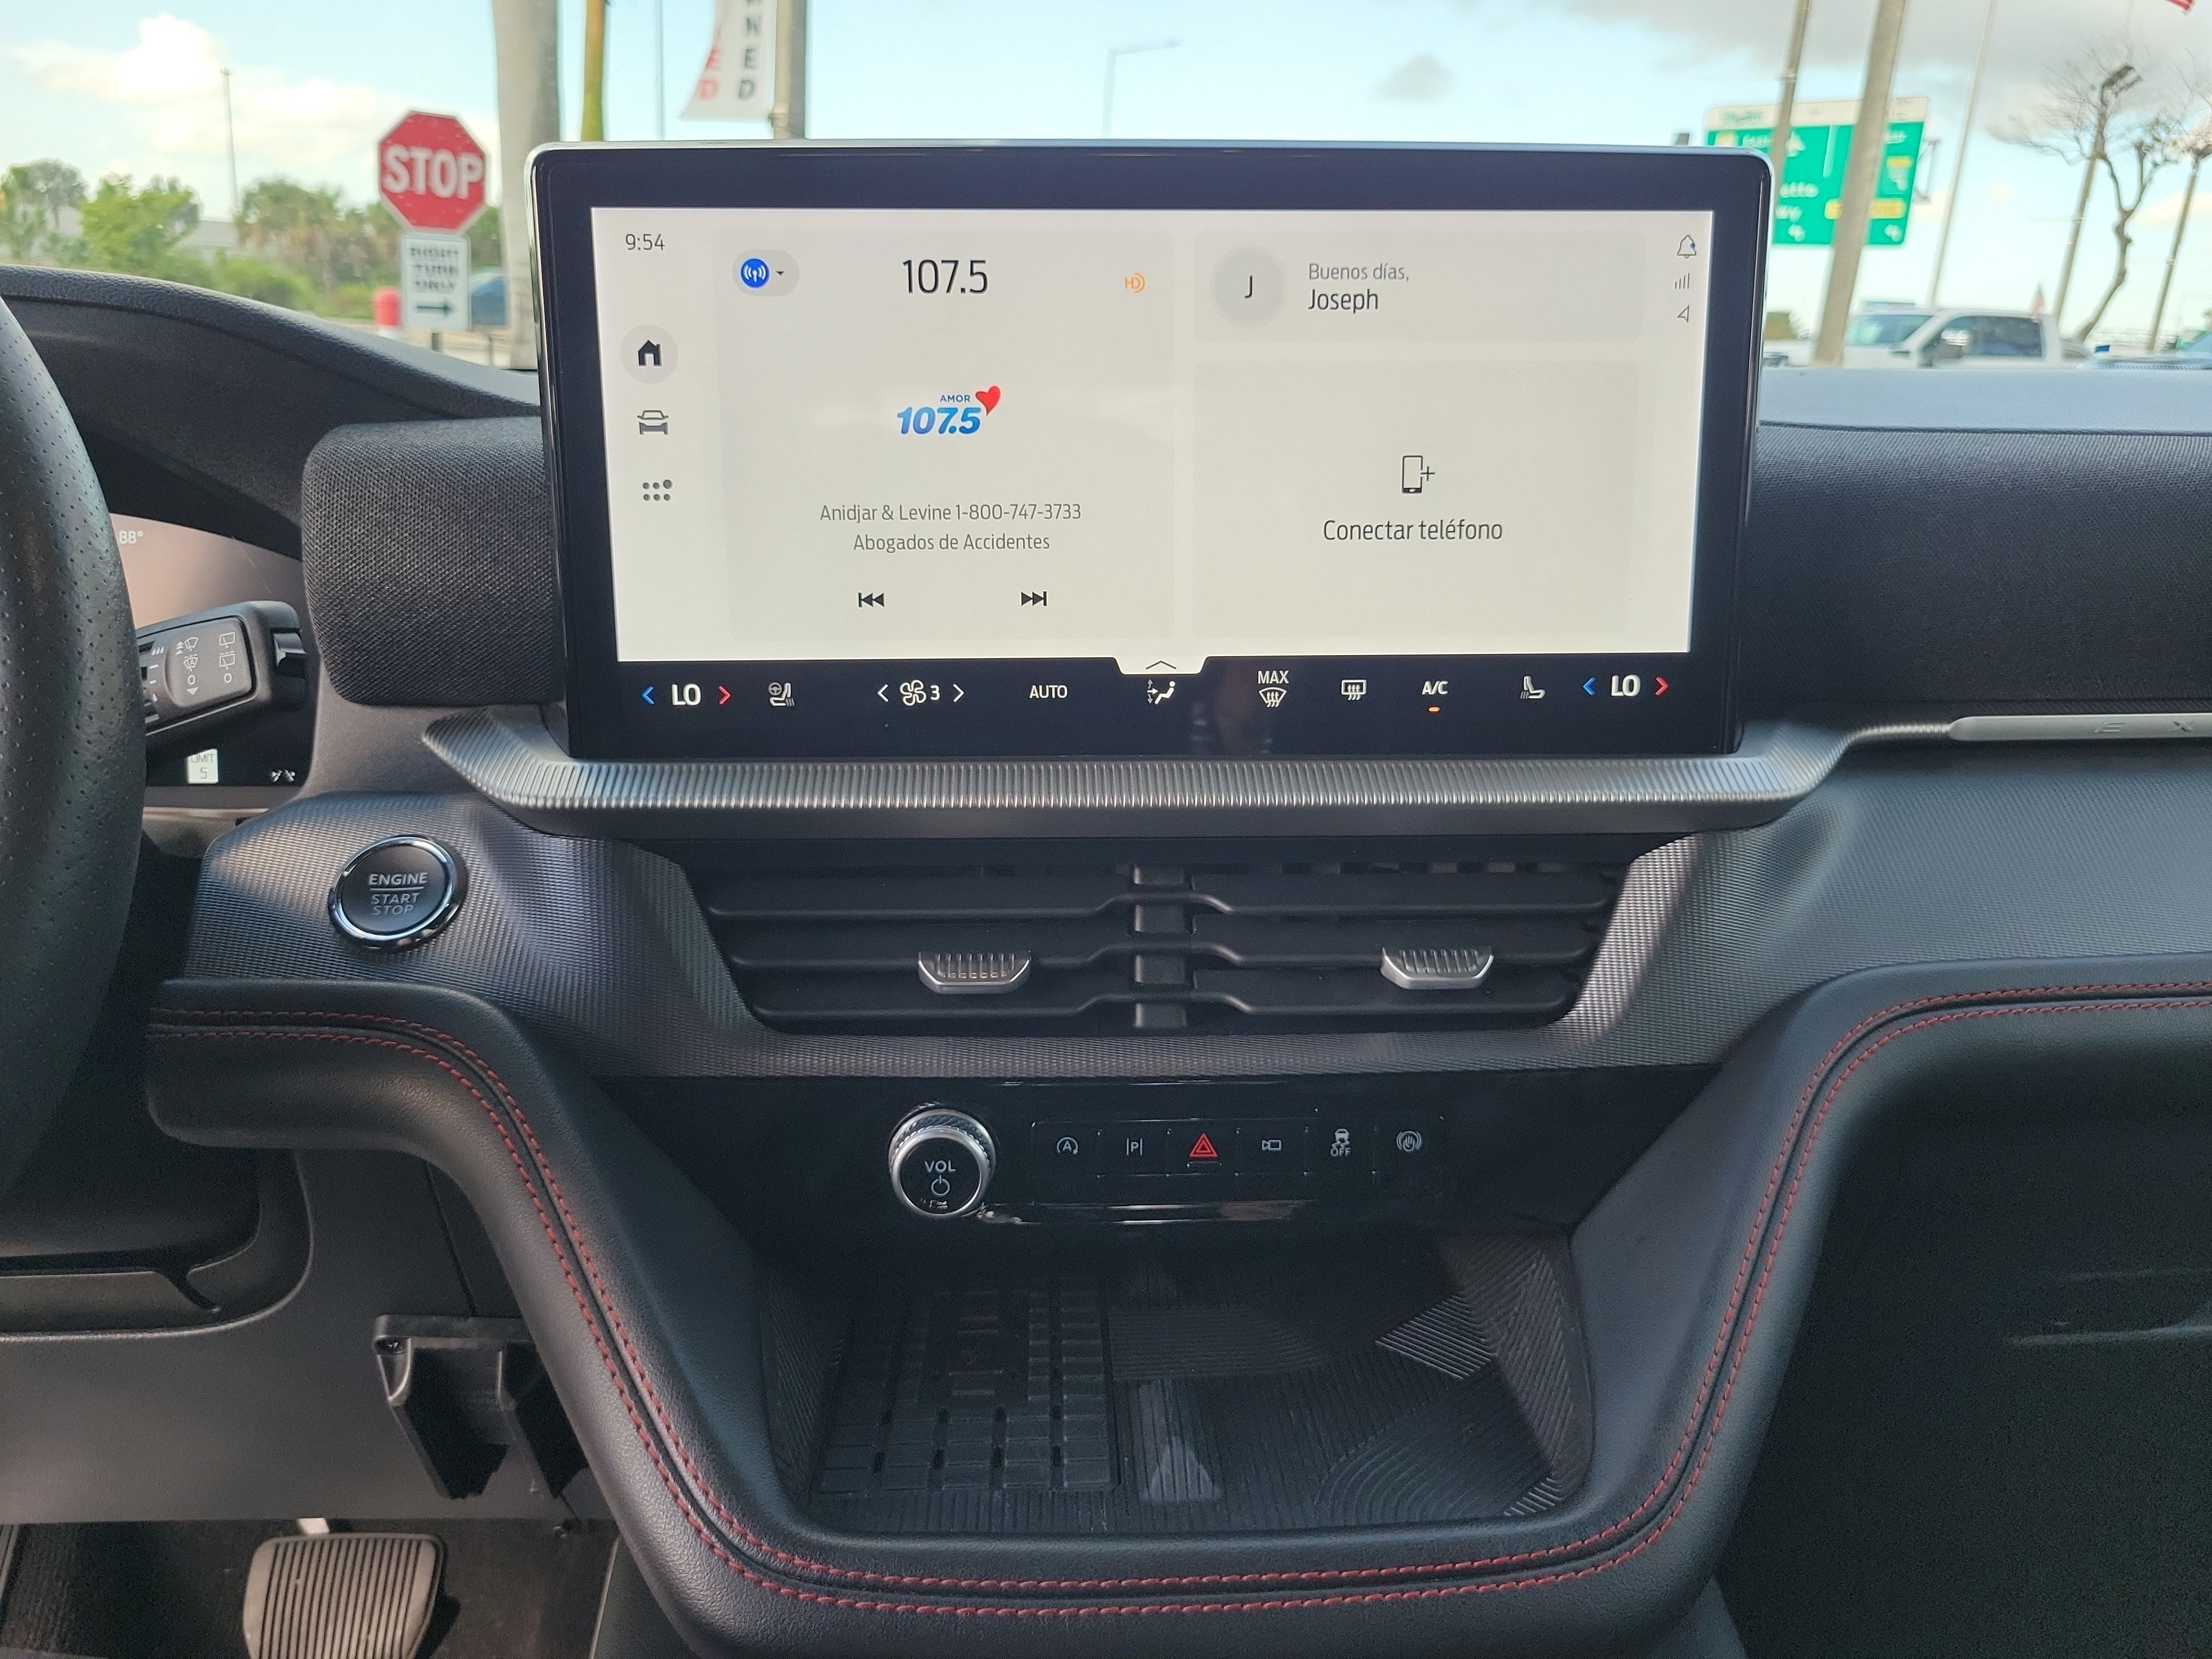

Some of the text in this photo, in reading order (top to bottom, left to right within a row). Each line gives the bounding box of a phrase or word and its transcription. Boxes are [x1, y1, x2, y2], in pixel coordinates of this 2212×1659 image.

[382, 144, 484, 199] STOP
[625, 233, 665, 251] 9:54
[902, 259, 988, 294] 107.5
[1308, 262, 1410, 282] Buenos días,
[1244, 275, 1254, 298] J
[1307, 289, 1379, 314] Joseph
[940, 394, 971, 403] AMOR
[897, 407, 981, 435] 107.5
[820, 504, 1081, 524] Anidjar & Levine 1-800-747-3733
[1323, 518, 1503, 540] Conectar teléfono
[854, 533, 1050, 553] Abogados de Accidentes
[1258, 670, 1289, 684] MAX
[930, 685, 940, 701] 3
[1029, 685, 1068, 698] AUTO
[1421, 680, 1448, 695] A/C
[1610, 675, 1640, 697] LO
[672, 684, 701, 706] LO
[190, 753, 215, 764] LIMIT
[200, 767, 208, 779] 5
[369, 872, 428, 886] ENGINE
[370, 893, 421, 905] START
[372, 904, 415, 916] STOP
[1330, 1147, 1351, 1157] OFF
[924, 1160, 956, 1173] VOL
